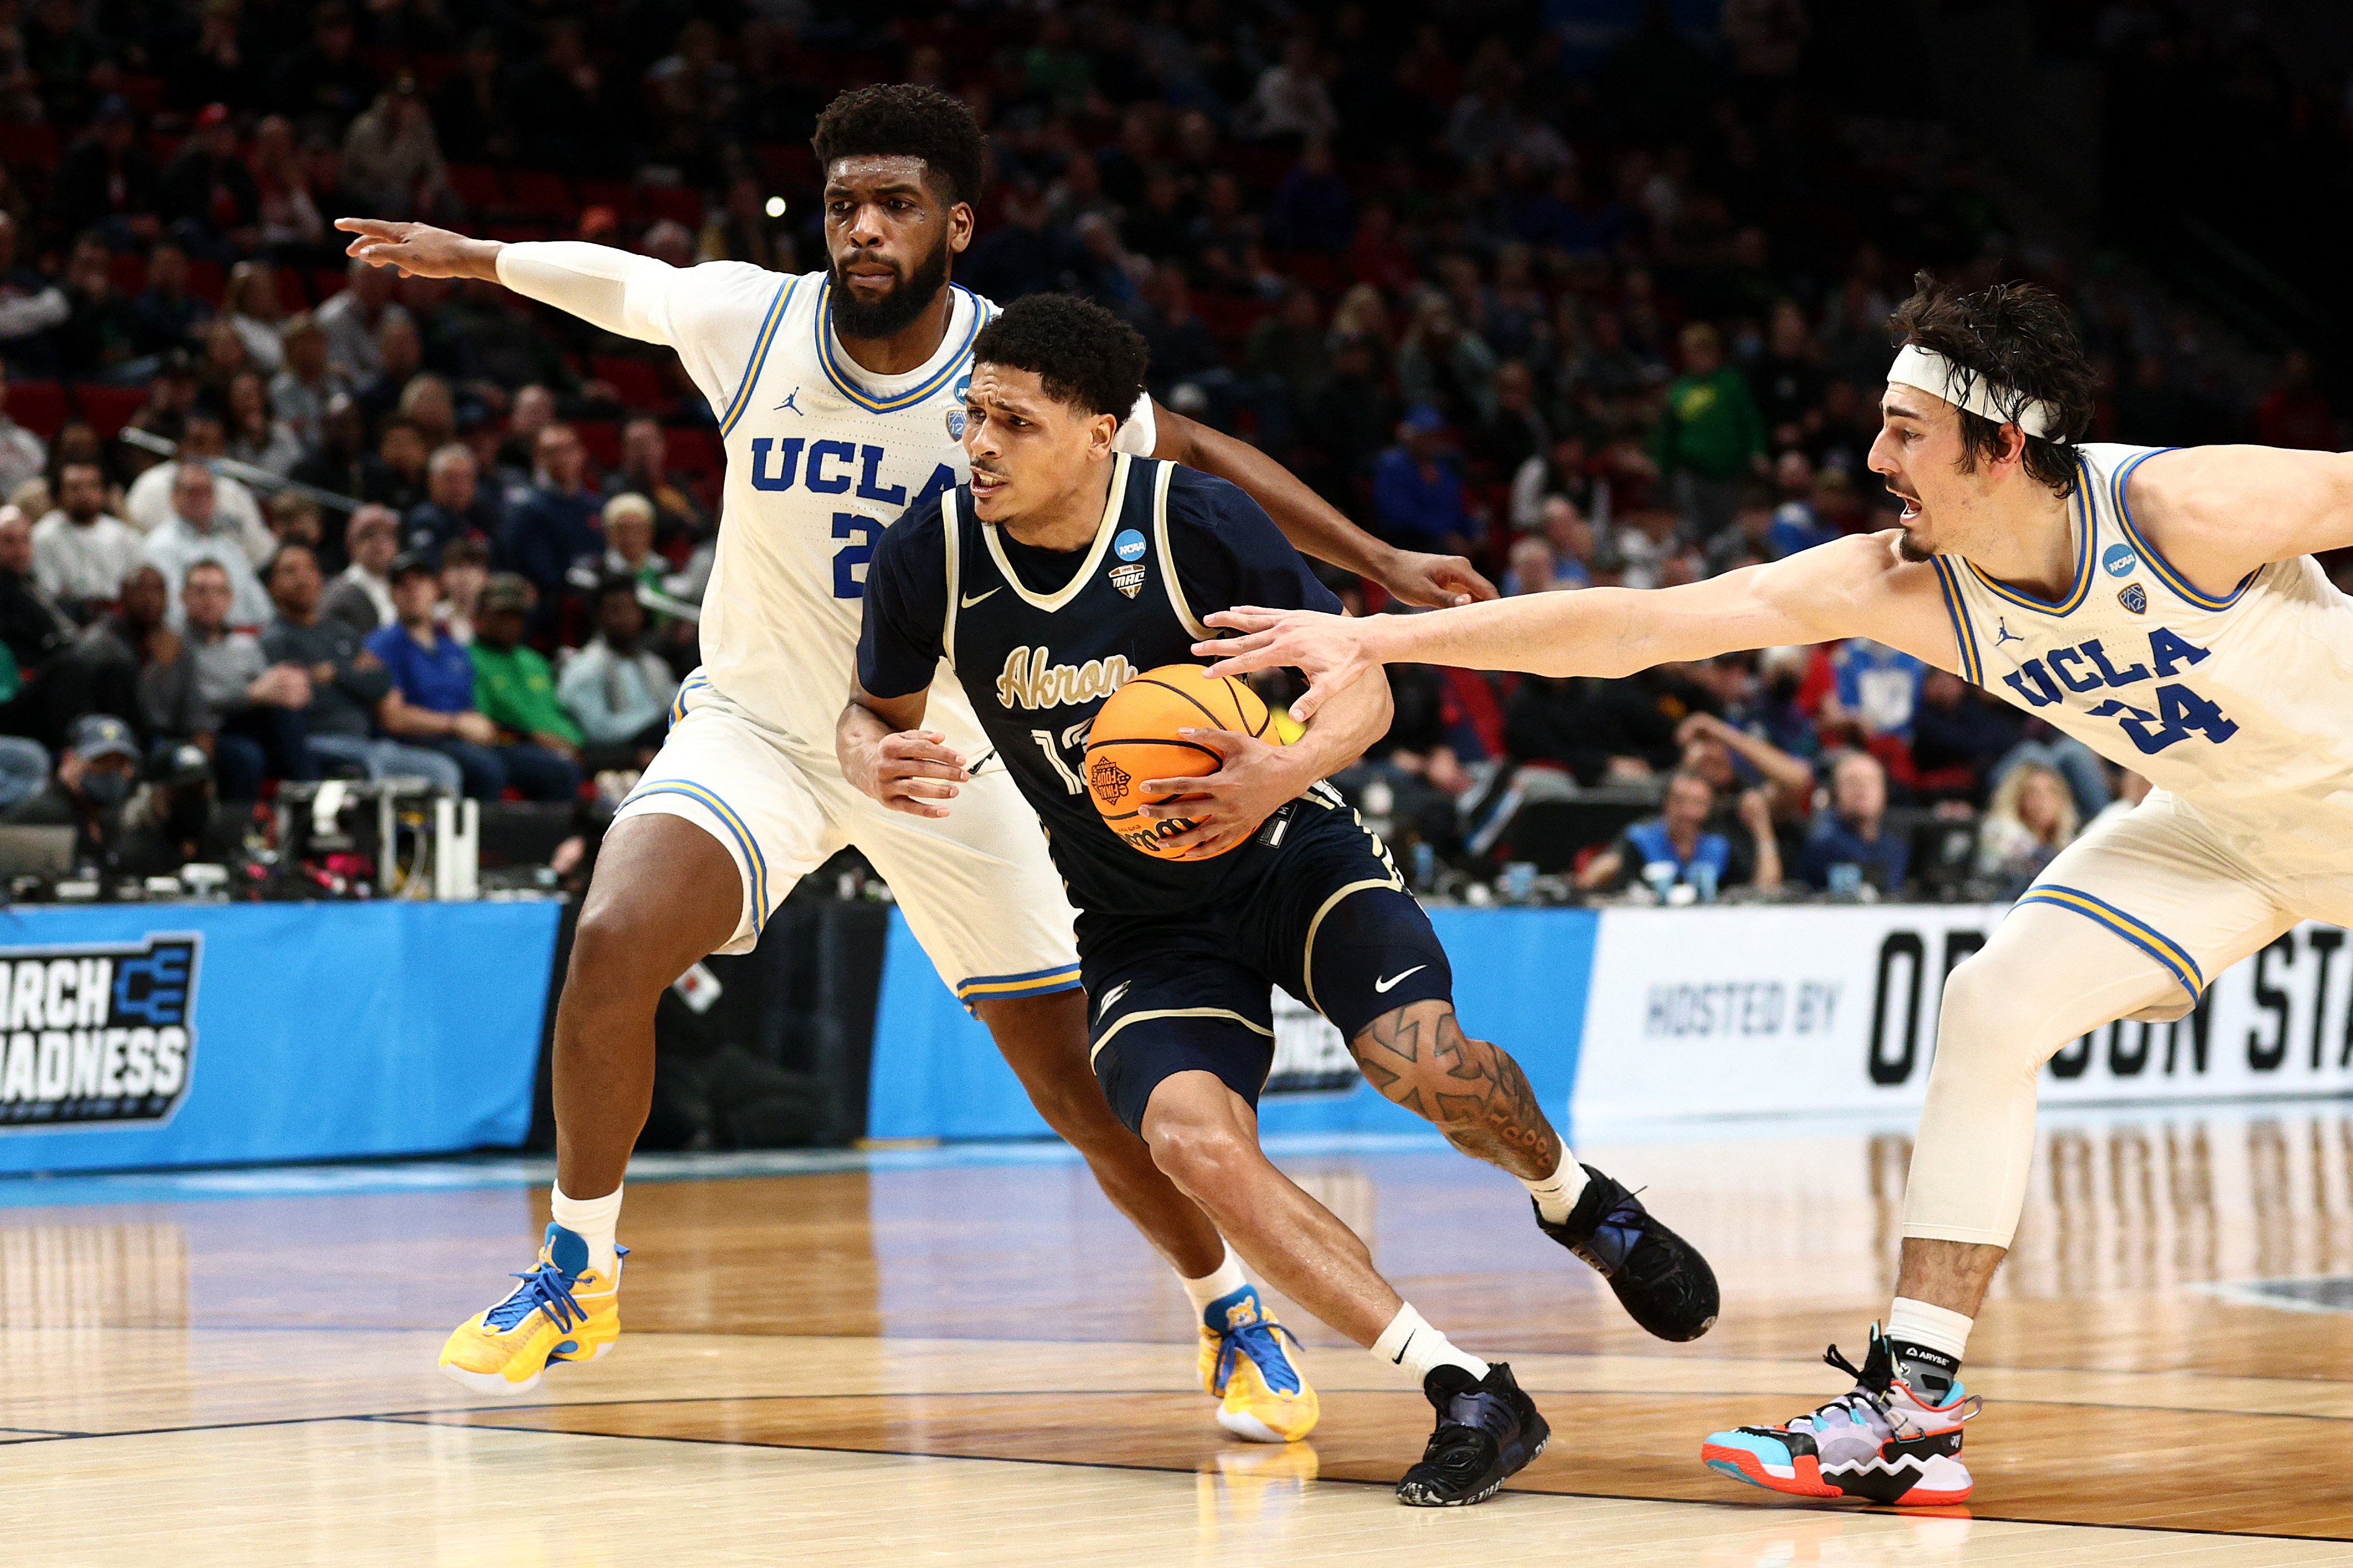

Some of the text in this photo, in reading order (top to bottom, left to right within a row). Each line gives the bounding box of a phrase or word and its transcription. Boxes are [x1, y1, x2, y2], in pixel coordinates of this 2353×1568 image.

[948, 411, 967, 425] PA
[1119, 542, 1145, 555] NCAA
[2109, 554, 2135, 572] NCAA
[1112, 572, 1145, 588] MAC
[996, 646, 1139, 710] Akron
[2002, 626, 2211, 707] UCLA
[2084, 684, 2240, 754] 24
[1277, 807, 1290, 815] M
[1646, 977, 1844, 1037] HOSTED BY
[2247, 930, 2353, 1070] ST
[0, 1026, 187, 1103] ADNESS
